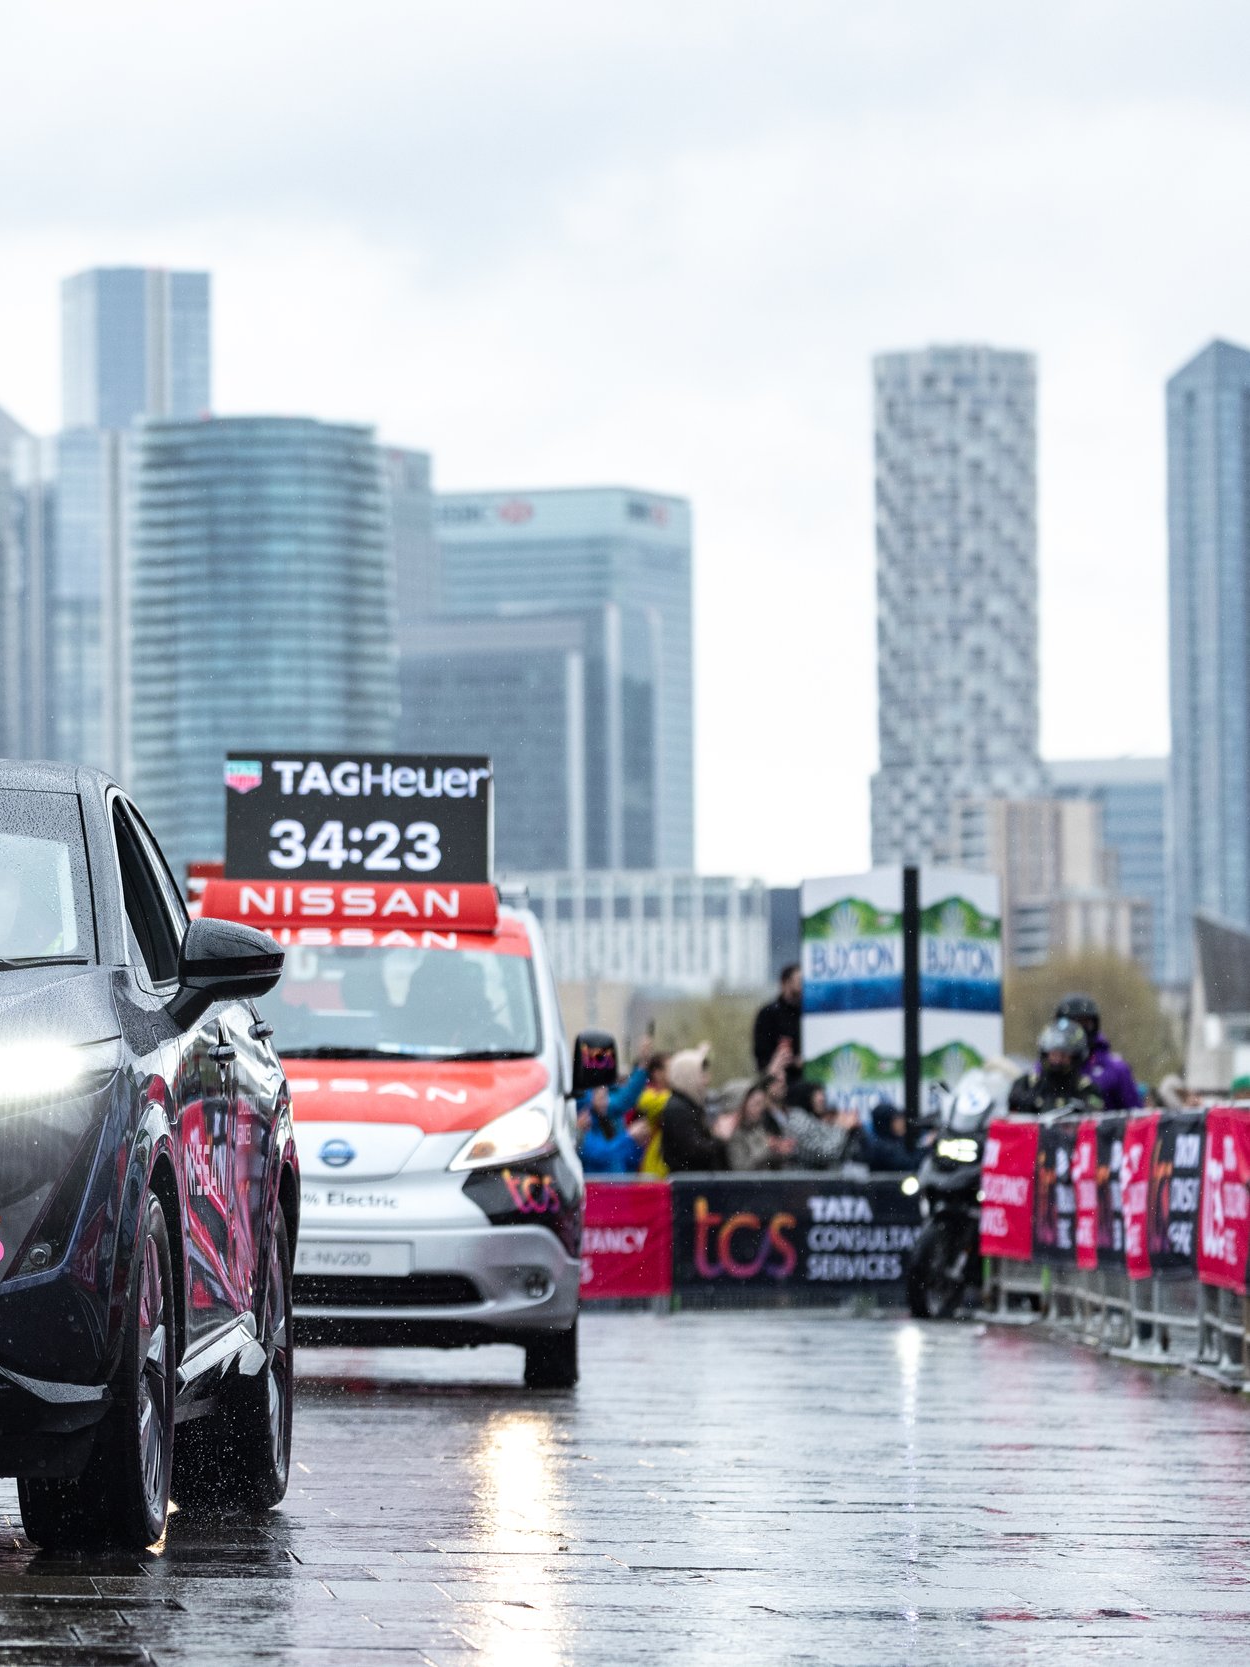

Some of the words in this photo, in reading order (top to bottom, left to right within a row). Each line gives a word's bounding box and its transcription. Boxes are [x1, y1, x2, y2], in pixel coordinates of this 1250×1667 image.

[268, 819, 442, 872] 34:23
[239, 886, 460, 918] NISSAN
[263, 927, 458, 950] ISSAN
[811, 941, 895, 979] BUXTON
[290, 1078, 468, 1104] SSAN
[327, 1191, 399, 1209] Electric
[500, 1168, 560, 1214] tcs
[806, 1195, 874, 1223] TATA
[694, 1195, 798, 1280] tcs
[805, 1253, 903, 1281] SERVICES
